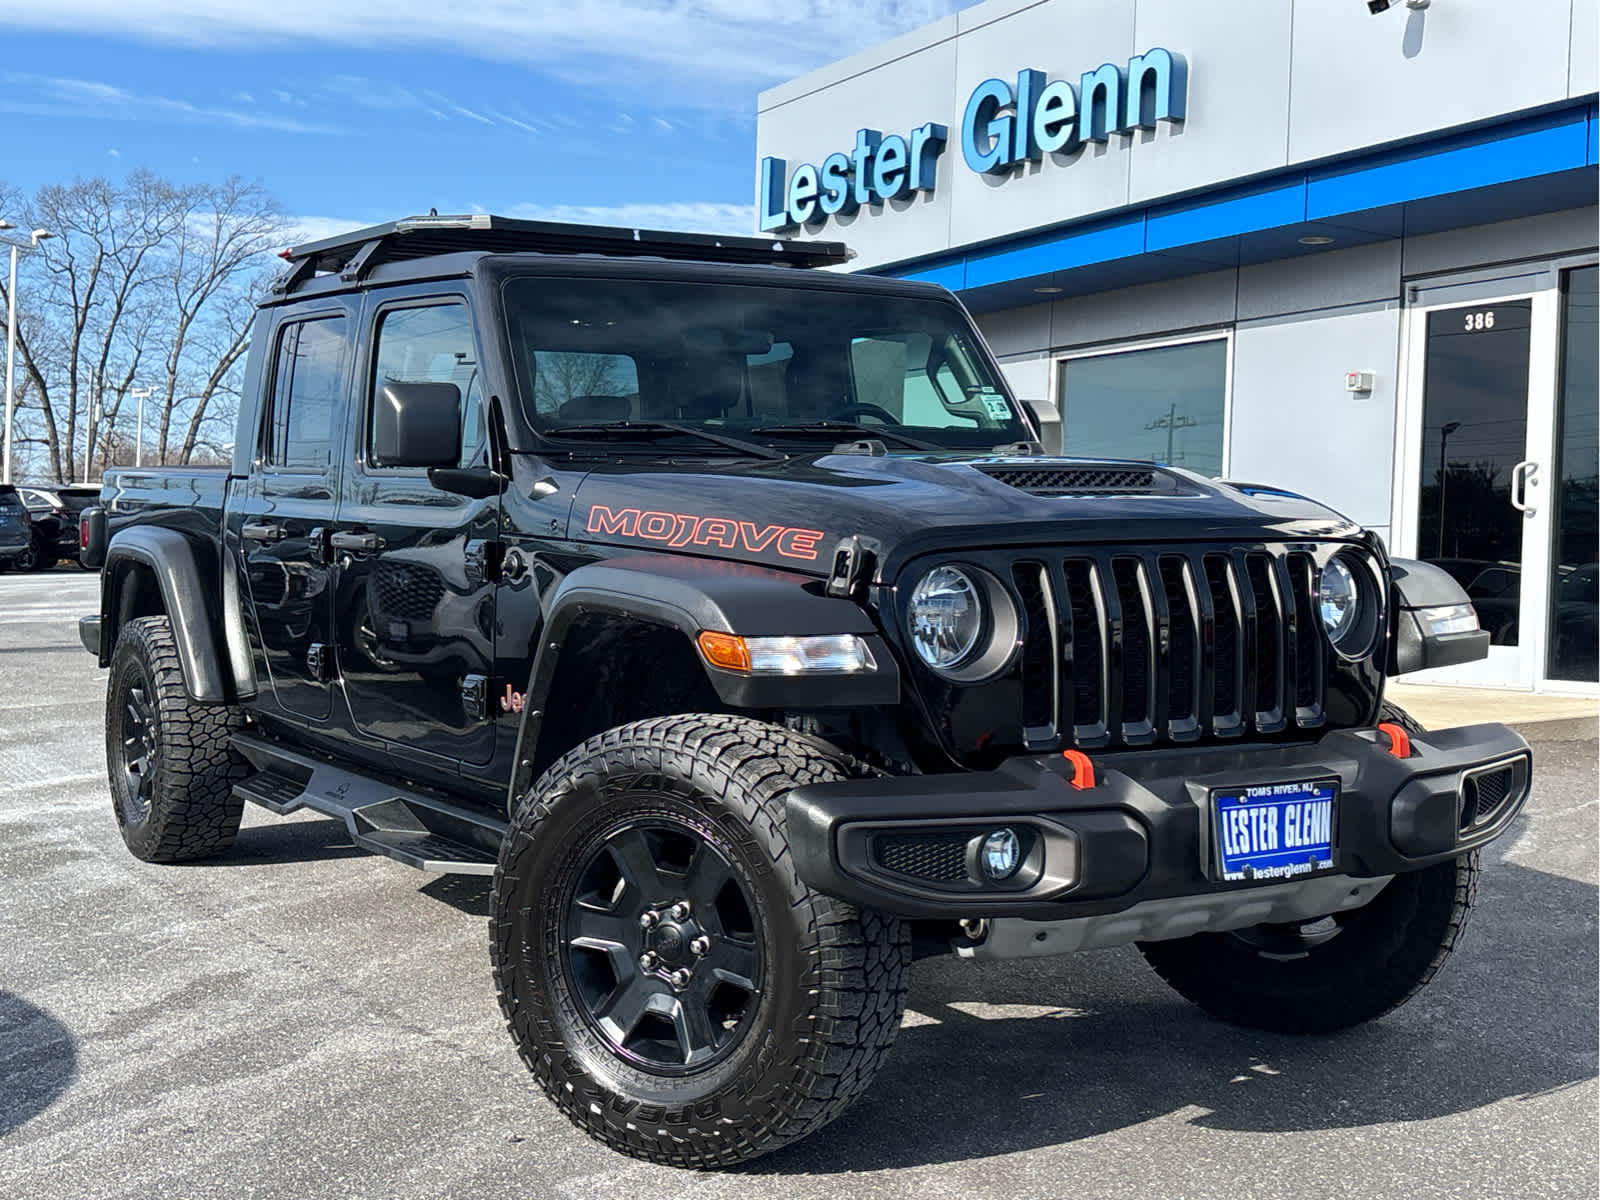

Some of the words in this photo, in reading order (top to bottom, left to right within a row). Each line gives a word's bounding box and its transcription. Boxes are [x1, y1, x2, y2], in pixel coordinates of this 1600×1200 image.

[760, 122, 948, 234] Lester
[962, 48, 1188, 176] Glenn
[1464, 311, 1495, 331] 386
[587, 505, 824, 560] MOJAVE
[1246, 785, 1272, 798] TOMS
[1302, 782, 1314, 793] NJ
[1222, 806, 1279, 856] LESTER
[1285, 800, 1332, 848] GLENN
[1253, 862, 1312, 880] lesterglenn
